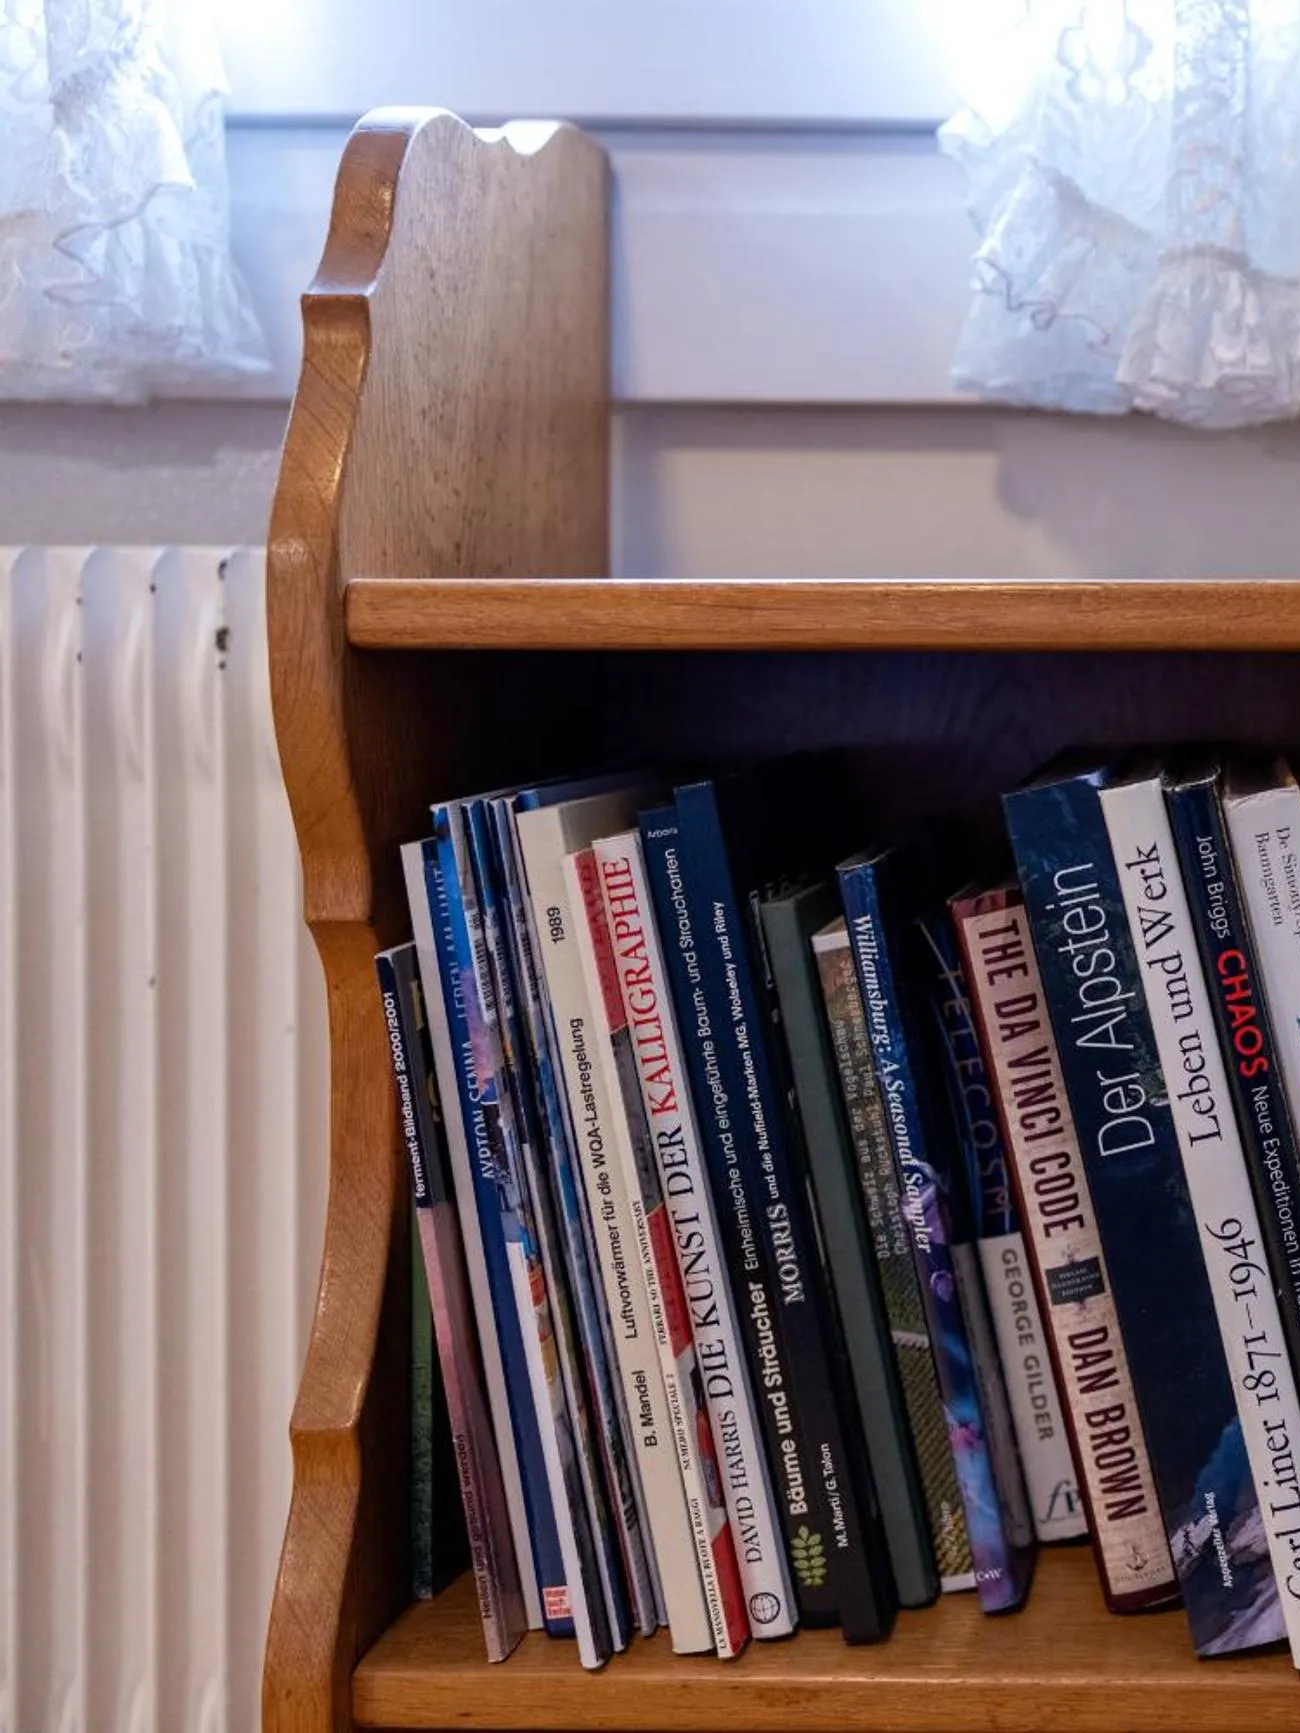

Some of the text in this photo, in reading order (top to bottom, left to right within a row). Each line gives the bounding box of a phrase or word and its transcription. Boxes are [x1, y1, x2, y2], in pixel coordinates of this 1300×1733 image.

[1195, 835, 1217, 878] John
[1205, 881, 1230, 938] Briggs
[1254, 831, 1283, 925] Baumgarten
[978, 919, 1028, 984] THE
[1047, 863, 1154, 1156] Der Alpstein
[1125, 842, 1222, 1146] Leben und Werk
[994, 992, 1040, 1041] DA
[1217, 949, 1267, 1076] CHAOS
[383, 992, 425, 1197] ferment-Bildband 2000/2001
[712, 901, 803, 1302] MORRIS und die Nuffield-Marken MG, Wolseley und Riley
[832, 1019, 890, 1258] Die Schweiz aus der Vogelschau
[854, 915, 931, 1252] Williamsburg: A Seasonal Sampler
[1008, 1045, 1063, 1141] VINCI
[1251, 1085, 1273, 1134] Neue
[547, 905, 657, 1447] B. Mandel Luftvorwärmer für die WQA-Lastregelung 1989
[602, 858, 762, 1563] DAVID HARRIS DIE KUNST DER KALLIGRAPHIE
[664, 848, 807, 1514] Bäume und Sträucher Einheimische und eingeführte Baum- und Straucharten
[1029, 1151, 1084, 1236] CODE
[1262, 1137, 1298, 1253] Expeditionen
[1001, 1248, 1054, 1440] GEORGE GILDER
[1068, 1326, 1119, 1393] DAN
[1085, 1404, 1146, 1520] BROWN
[1203, 1491, 1218, 1526] Verlag
[471, 1545, 485, 1571] und
